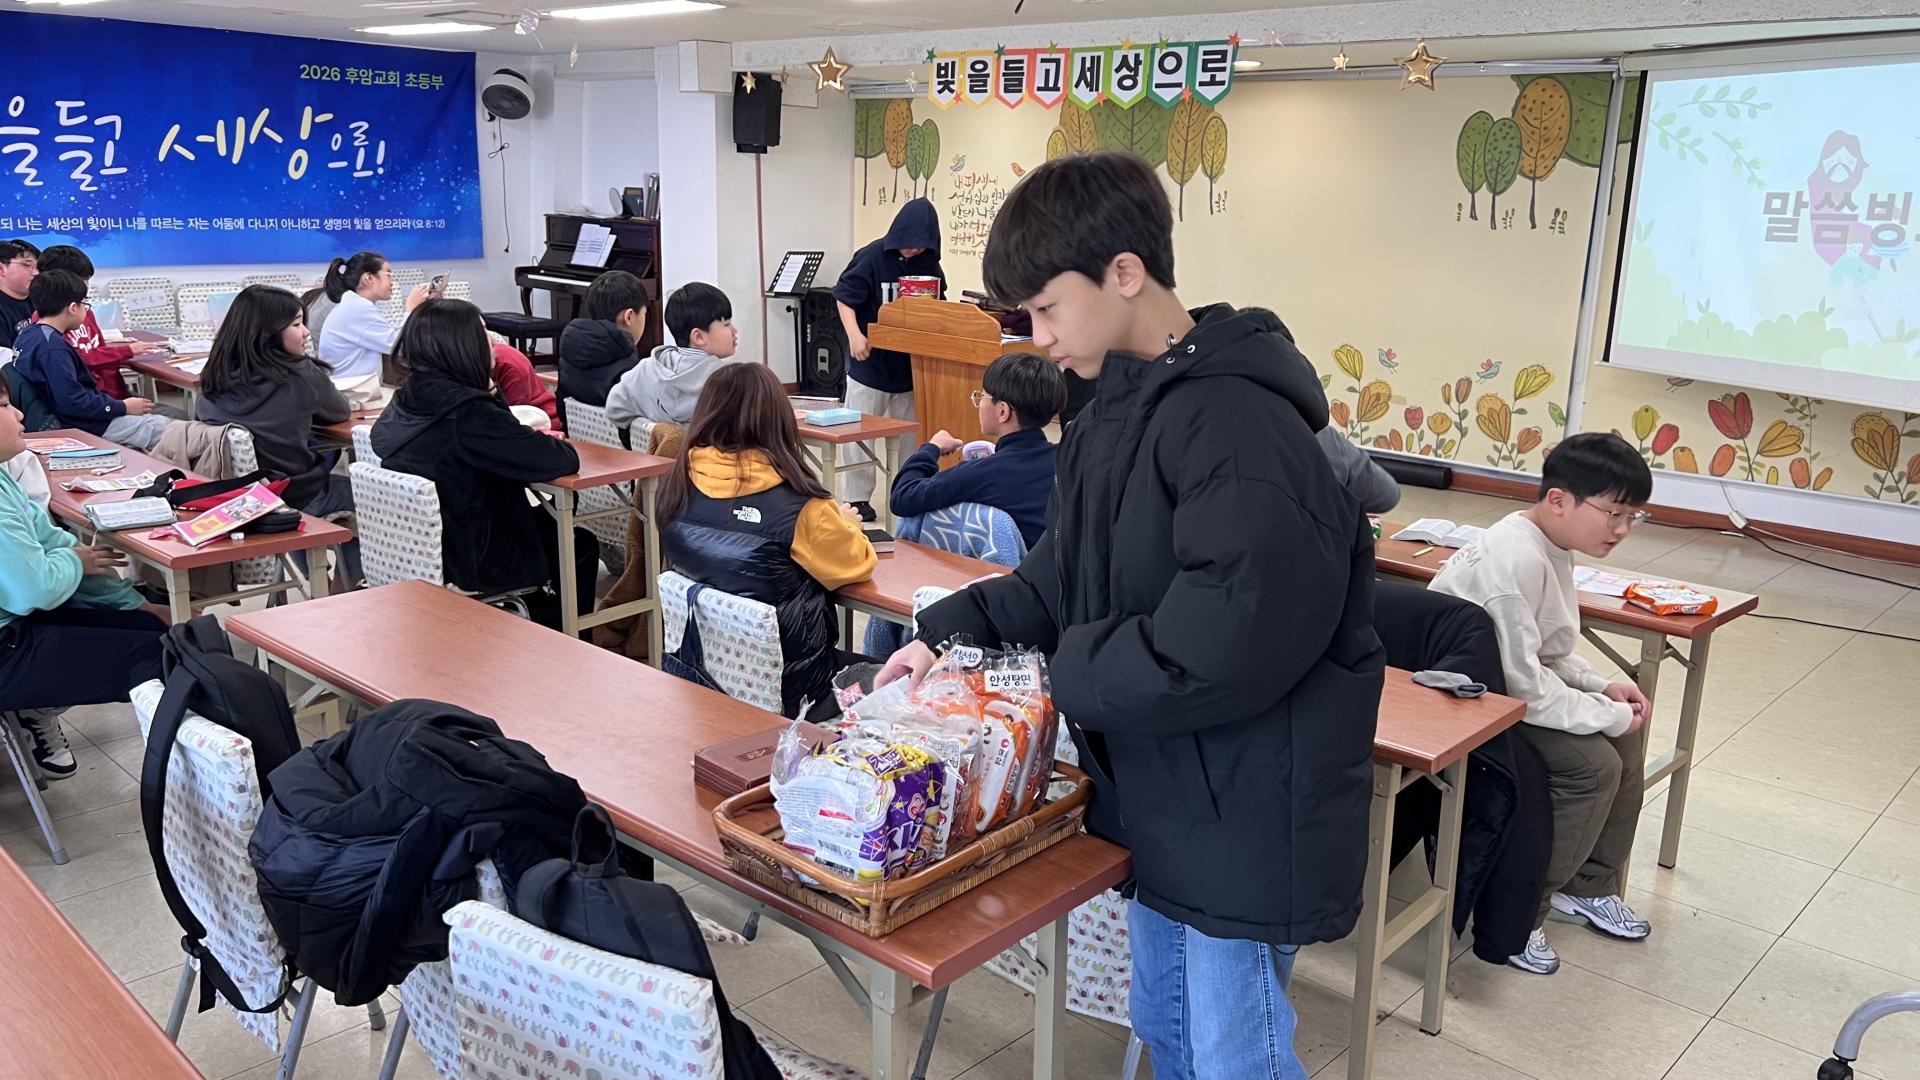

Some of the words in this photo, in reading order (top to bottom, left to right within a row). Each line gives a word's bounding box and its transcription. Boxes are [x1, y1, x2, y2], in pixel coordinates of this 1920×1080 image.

[300, 64, 341, 81] 2026
[345, 67, 400, 87] 후암교회
[404, 72, 445, 90] 초등부
[54, 100, 128, 191] 들고
[991, 188, 1010, 205] 인자
[17, 218, 43, 231] 나는
[47, 217, 83, 231] 세상의
[87, 216, 123, 231] 빛이니
[126, 217, 147, 231] 나를
[151, 217, 184, 230] 따르는
[187, 217, 209, 230] 자는
[212, 217, 245, 230] 어둠에
[247, 218, 278, 230] 다니지
[281, 218, 321, 230] 아니하고
[323, 217, 351, 230] 생명의
[354, 217, 372, 230] 빛을
[375, 218, 411, 230] 얻으리라
[425, 218, 445, 229] 8:12)
[1763, 190, 1920, 248] 말씀빙
[989, 673, 1031, 687] 안성탕면
